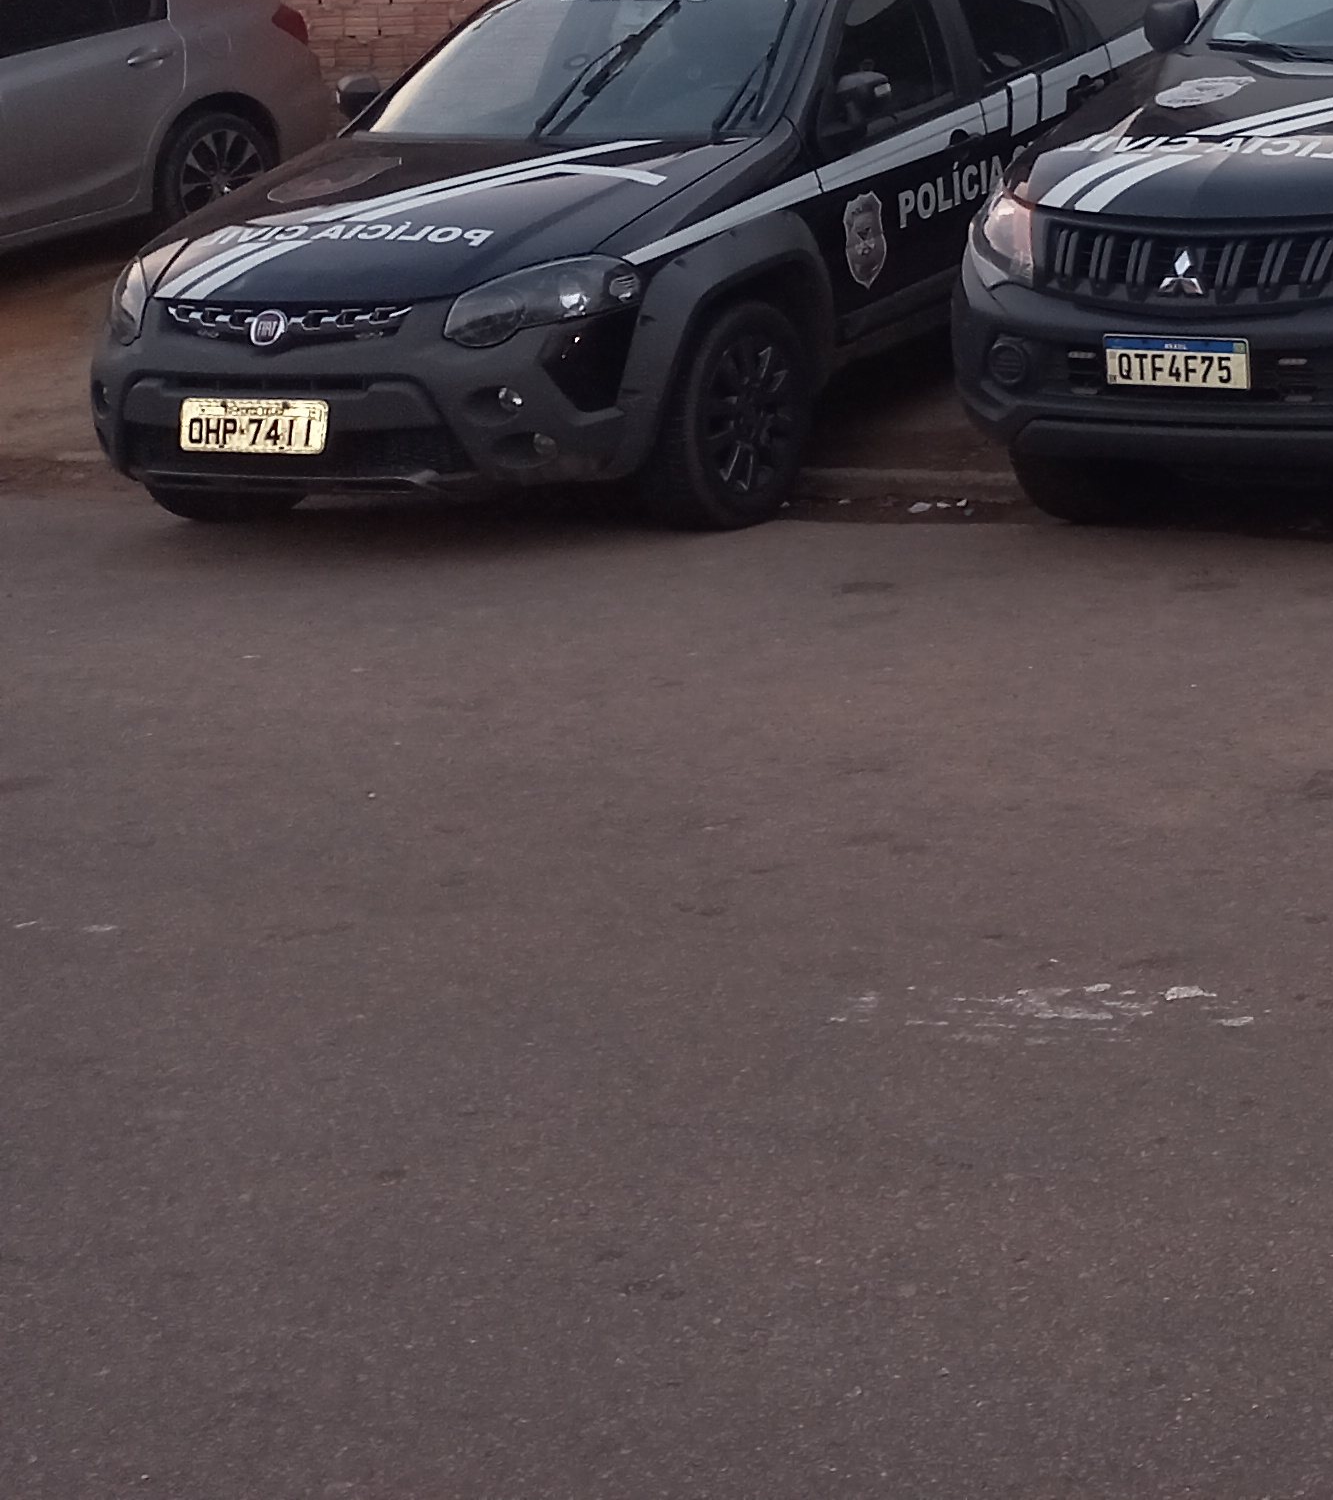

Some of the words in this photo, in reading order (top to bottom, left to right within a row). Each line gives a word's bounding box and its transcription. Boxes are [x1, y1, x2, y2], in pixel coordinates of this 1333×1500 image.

[898, 155, 1004, 229] POLÍCIA
[257, 321, 278, 337] FIAT
[1117, 352, 1231, 385] QTF4F75
